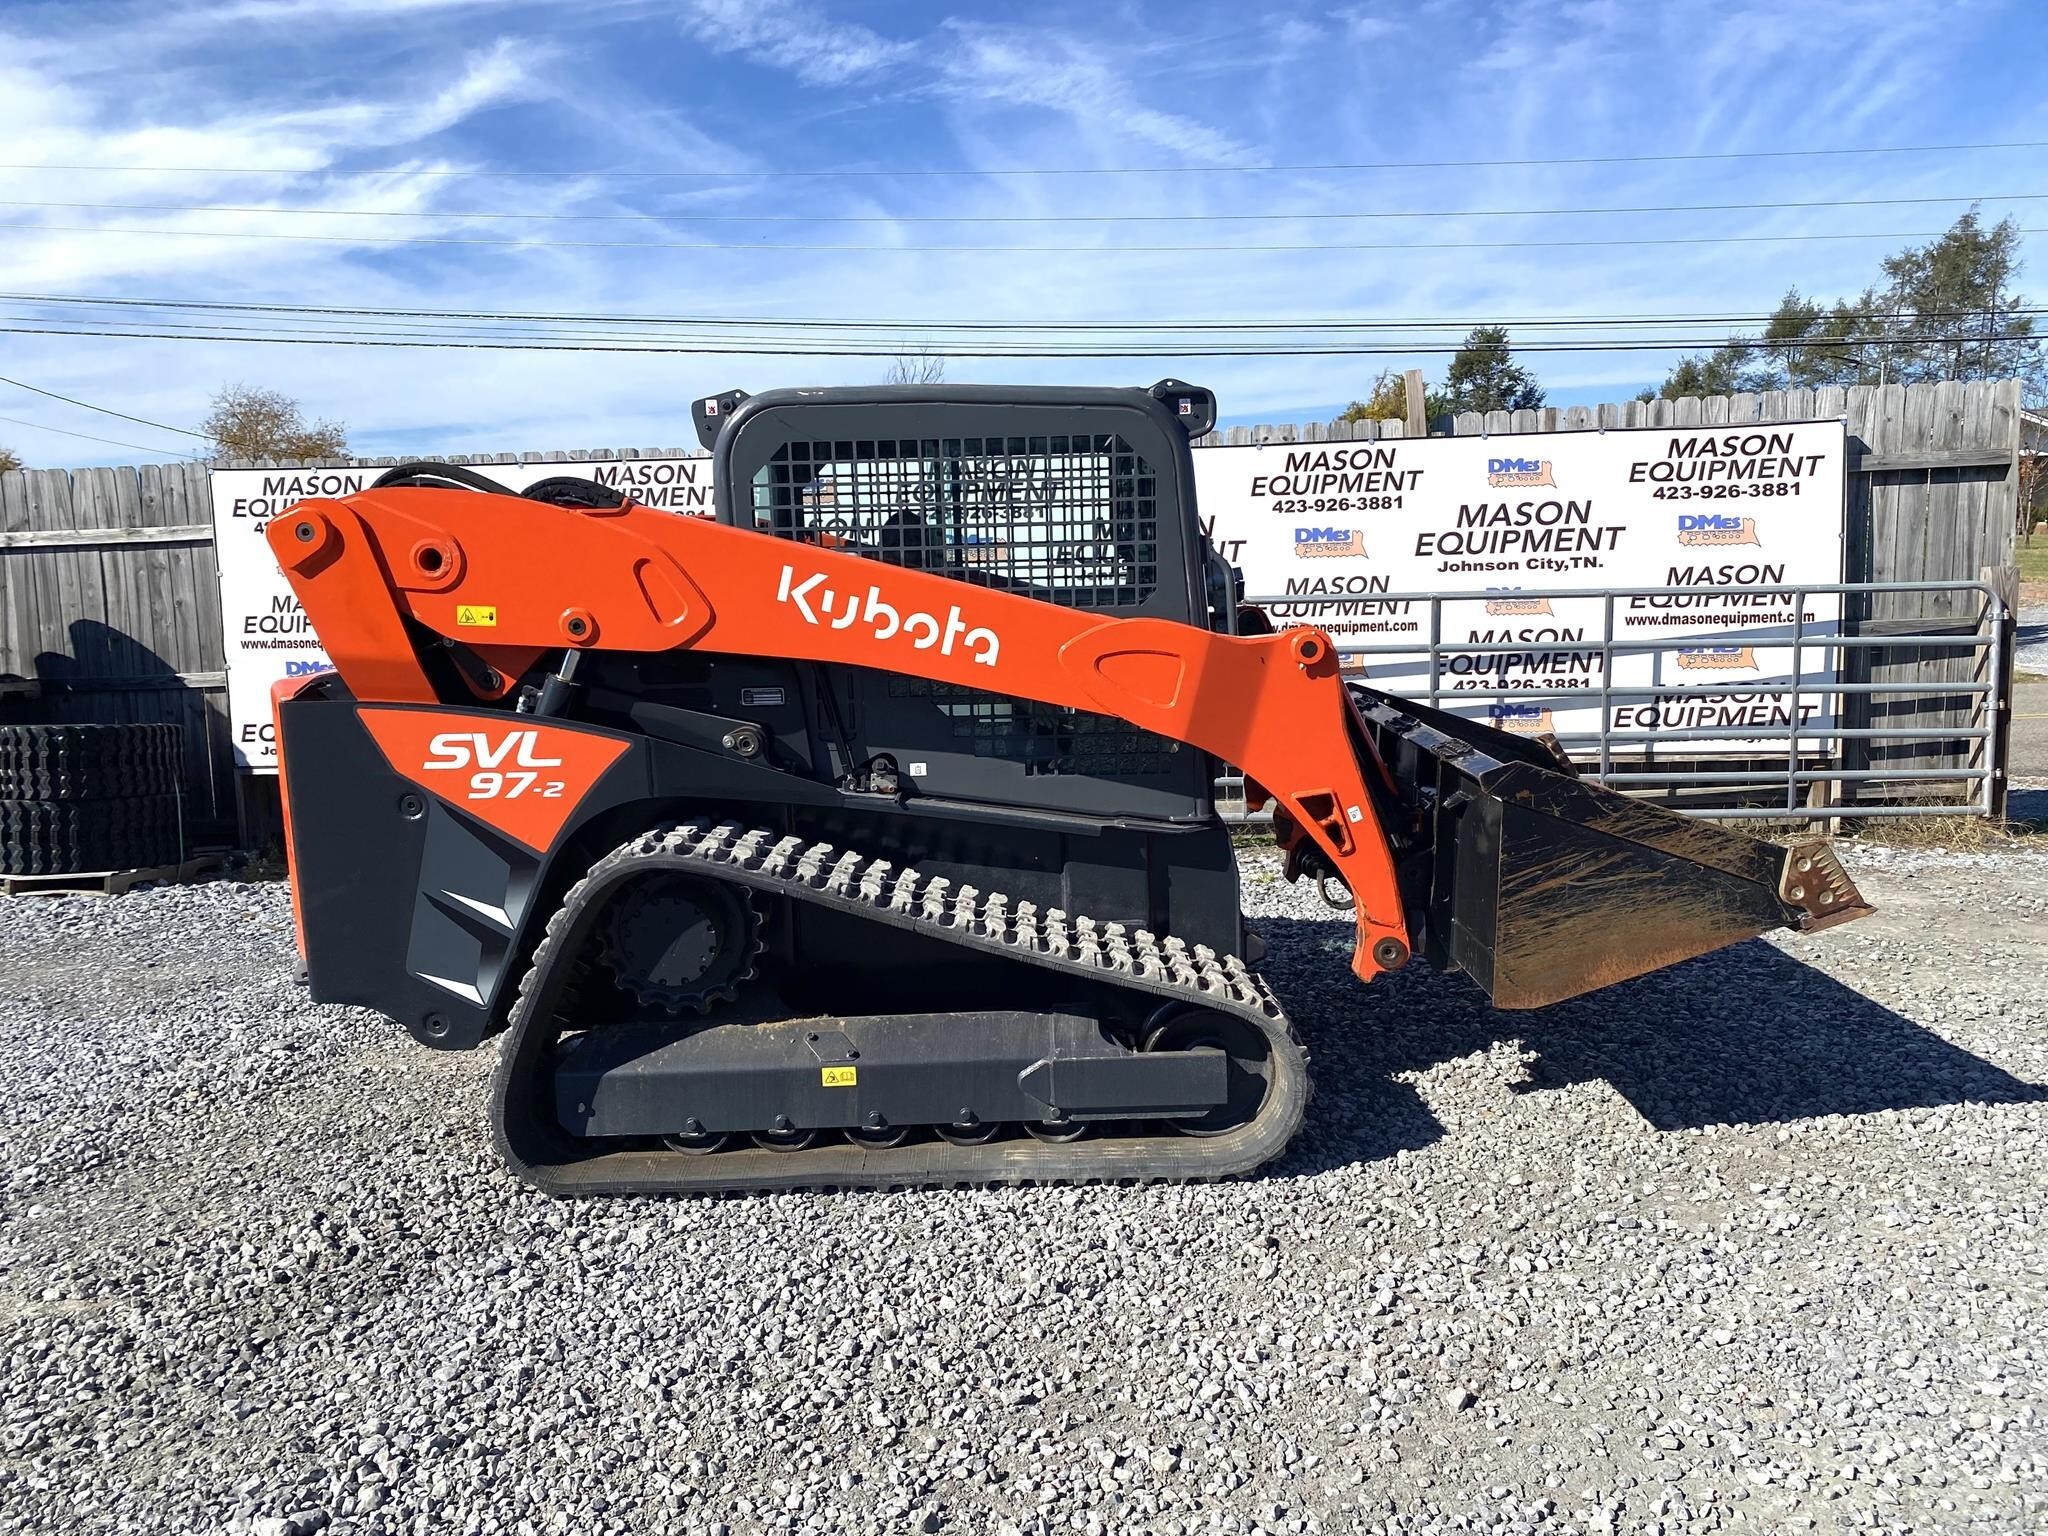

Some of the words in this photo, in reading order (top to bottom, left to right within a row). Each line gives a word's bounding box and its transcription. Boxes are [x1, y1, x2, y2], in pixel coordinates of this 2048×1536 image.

[1667, 433, 1794, 458] MASON
[1285, 448, 1396, 472] MASON
[1629, 455, 1826, 483] EQUIPMENT
[262, 475, 363, 497] MASON
[594, 463, 697, 486] MASON
[1251, 470, 1424, 497] EQUIPMENT
[1653, 481, 1801, 500] 423-926-3881
[1272, 496, 1403, 513] 423-926-3881
[1456, 500, 1592, 528] MASON
[1415, 526, 1626, 557] EQUIPMENT
[1437, 560, 1519, 573] Johnson
[1526, 556, 1604, 571] City,TN.
[1666, 564, 1785, 586] MASON
[1285, 575, 1390, 595] MASON
[1630, 593, 1806, 609] EQUIPMEN
[776, 565, 1000, 667] Kubota
[1625, 611, 1815, 627] www.dmasonequipment.cm
[1614, 705, 1818, 728] EQUIPMENT
[422, 731, 563, 769] SVL
[467, 771, 565, 799] 97-2
